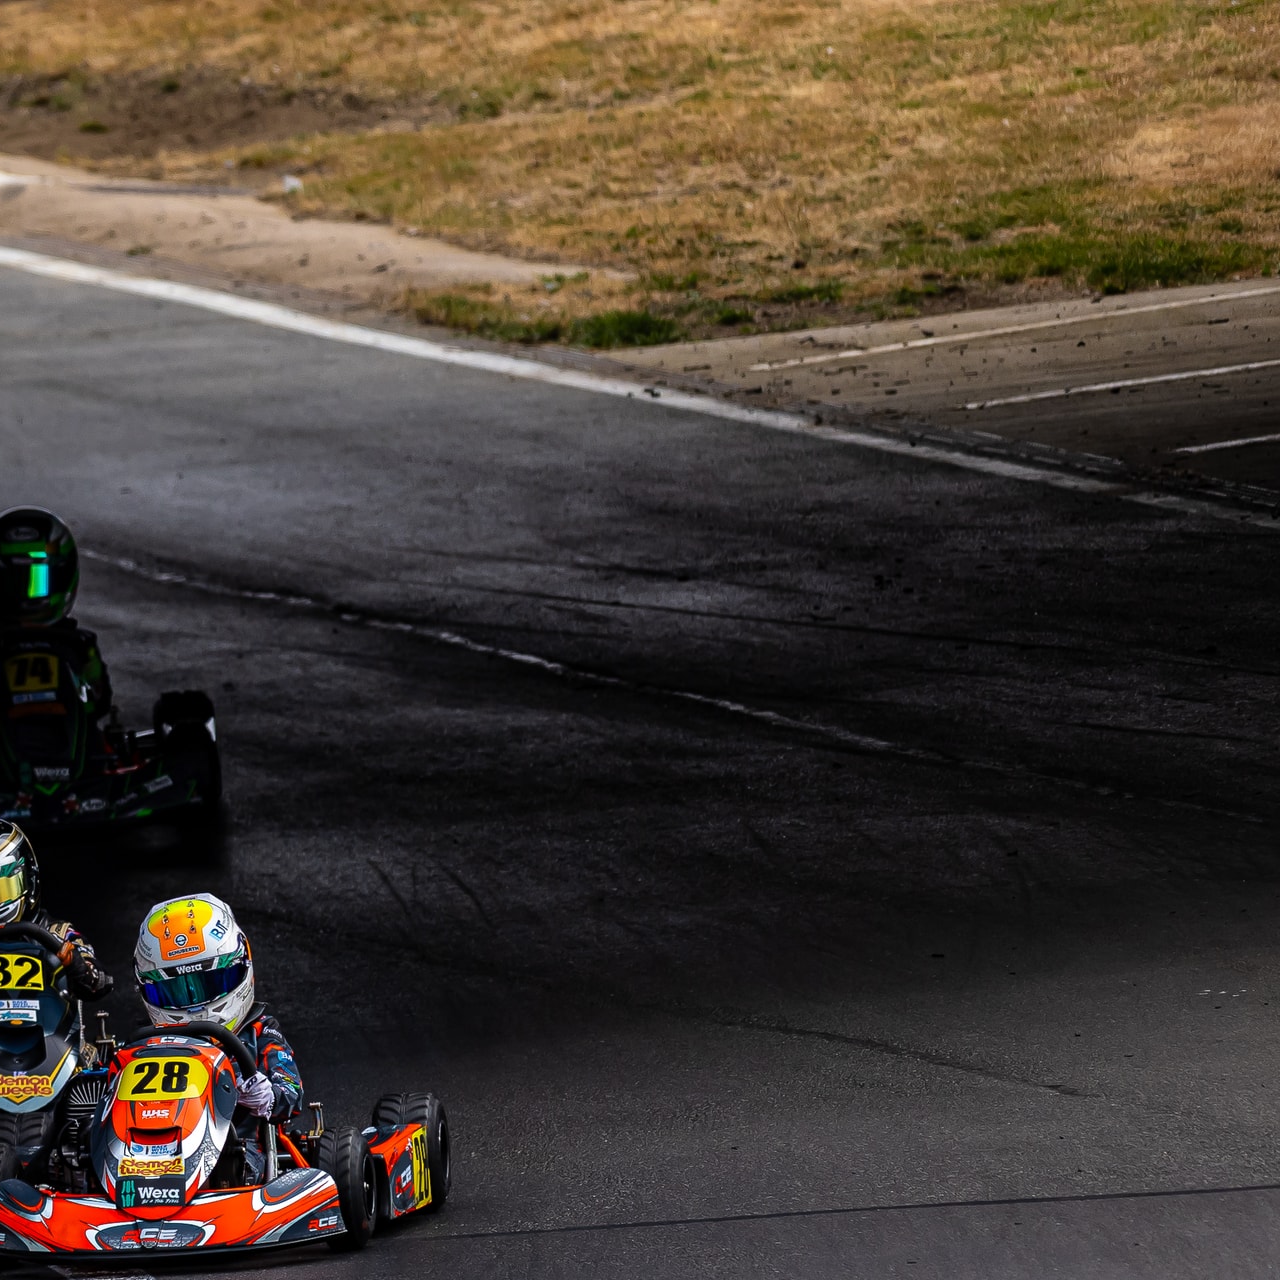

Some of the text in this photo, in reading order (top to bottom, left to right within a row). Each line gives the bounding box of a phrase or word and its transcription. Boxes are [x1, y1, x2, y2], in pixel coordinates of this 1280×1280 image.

[10, 658, 50, 685] 74
[168, 946, 200, 957] SCHUBERTH
[176, 963, 203, 975] Wera
[131, 1061, 190, 1095] 28
[122, 1158, 182, 1169] demon
[120, 1165, 183, 1176] tweeks
[138, 1187, 180, 1199] Wera
